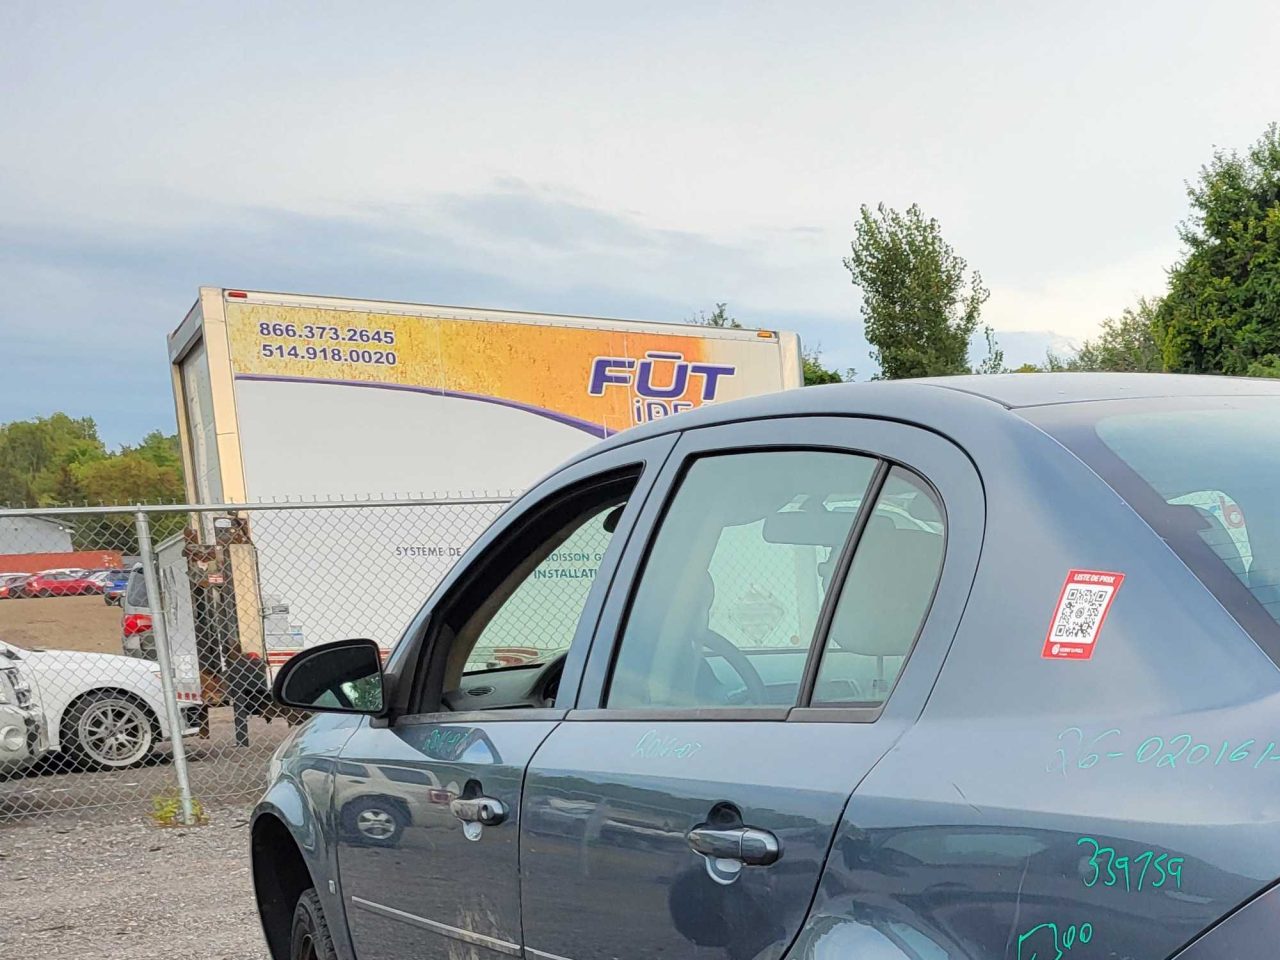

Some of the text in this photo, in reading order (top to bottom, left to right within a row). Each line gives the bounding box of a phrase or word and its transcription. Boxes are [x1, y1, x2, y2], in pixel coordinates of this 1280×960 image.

[259, 322, 395, 344] 866.373.2645
[262, 344, 396, 365] 514.918.0020
[396, 544, 444, 557] SYSTÈME
[449, 547, 462, 557] DE
